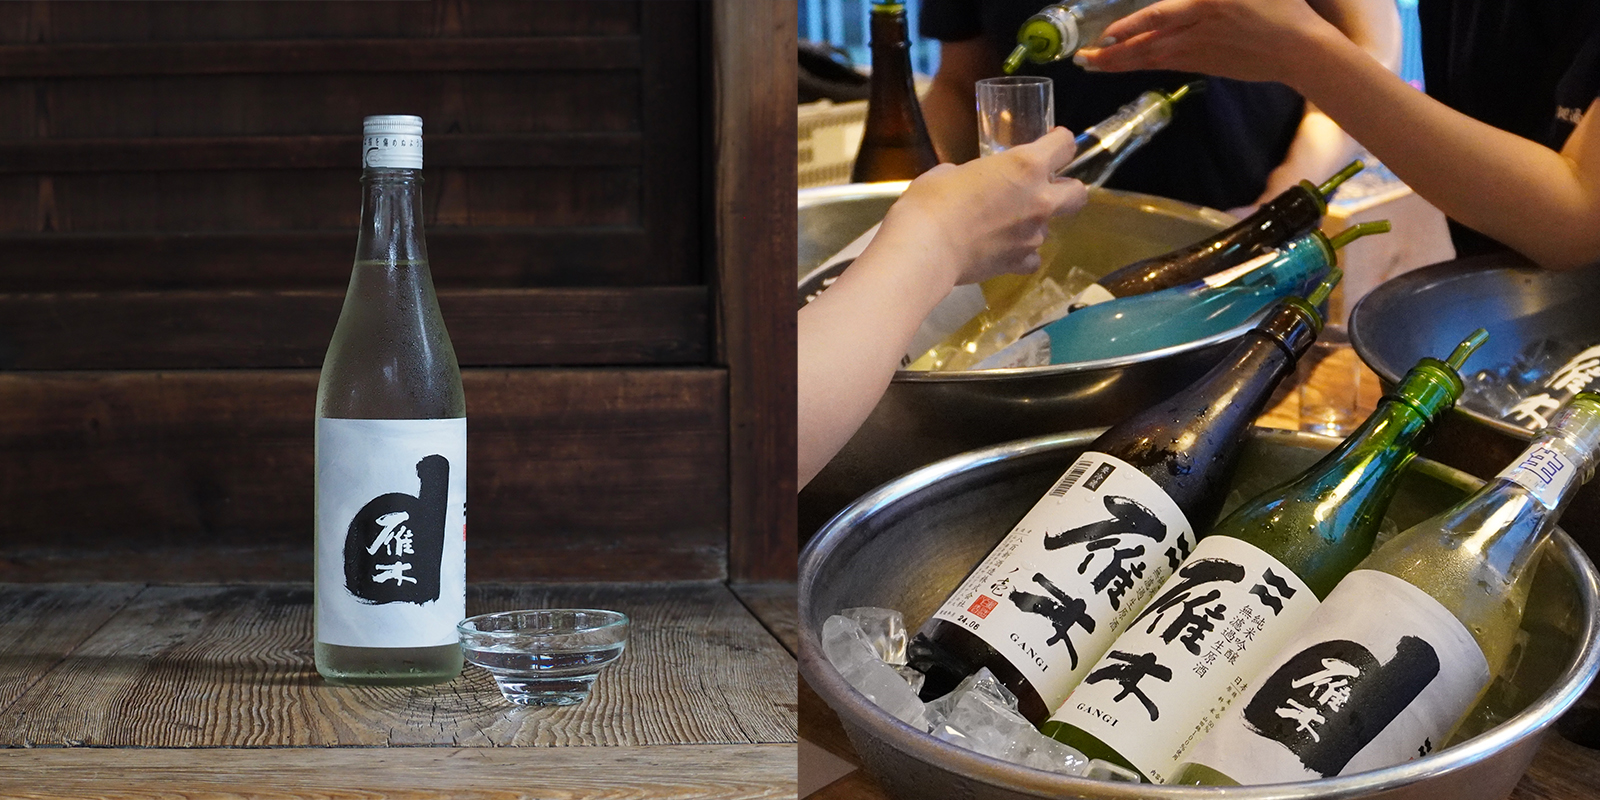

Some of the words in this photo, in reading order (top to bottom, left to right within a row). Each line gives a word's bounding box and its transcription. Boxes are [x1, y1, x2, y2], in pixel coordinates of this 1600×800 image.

[1519, 447, 1564, 485] 生
[366, 510, 418, 586] 雁木
[1009, 495, 1167, 671] 雁木
[1109, 566, 1163, 632] 無濾過生原酒
[957, 614, 980, 631] 24.06
[1009, 632, 1050, 673] GANGI
[1084, 557, 1246, 722] 雁木
[1192, 604, 1253, 679] 無濾過生原酒
[1223, 614, 1267, 666] 純米吟醸
[1076, 702, 1119, 728] GANGI
[1274, 657, 1360, 742] 雁木
